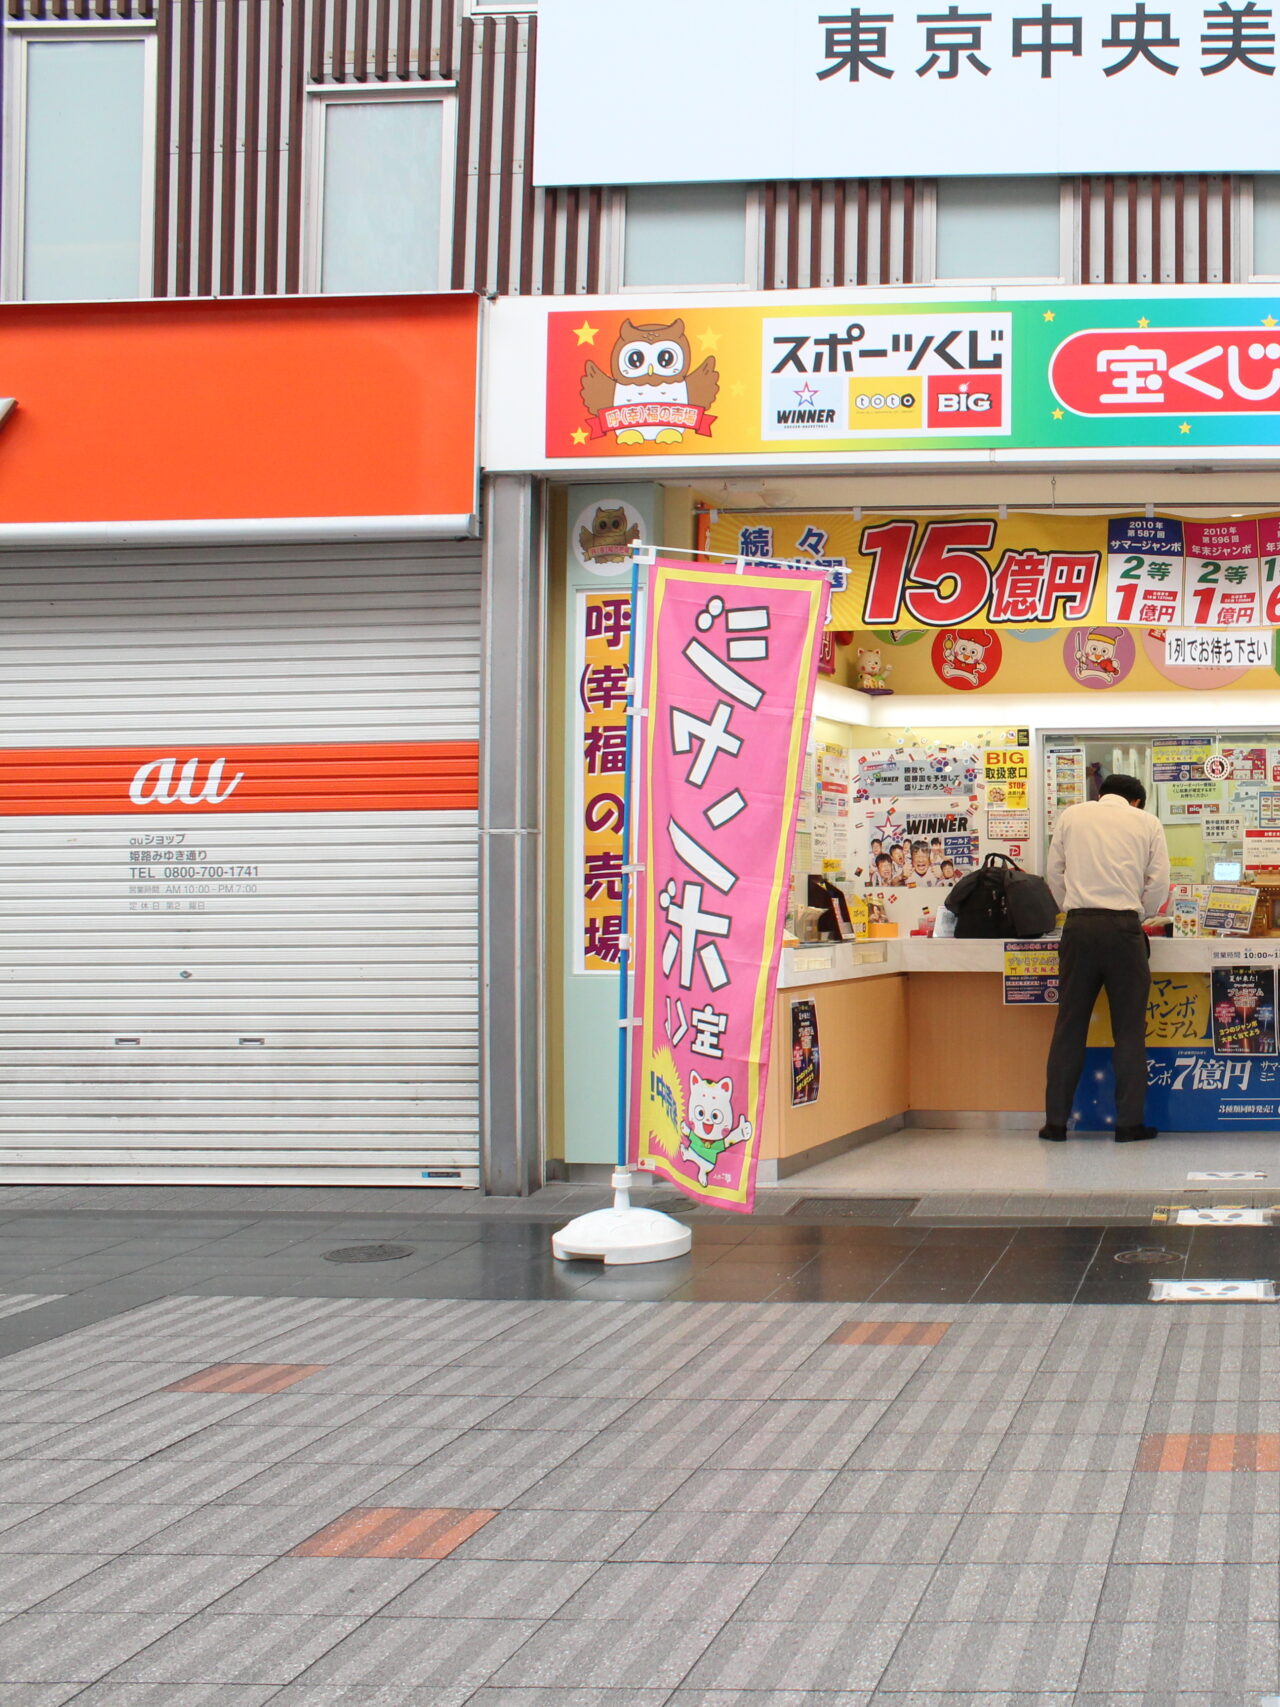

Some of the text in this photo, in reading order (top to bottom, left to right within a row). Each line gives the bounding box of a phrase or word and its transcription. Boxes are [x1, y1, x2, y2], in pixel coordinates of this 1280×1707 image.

[771, 322, 1003, 374] スポーツくじ
[777, 409, 836, 424] WINNER
[1110, 540, 1182, 552] サマージャンボ
[1191, 544, 1253, 556] 年末ジャンボ
[860, 520, 1101, 625] 15億円
[1120, 556, 1173, 581] 2等
[1197, 561, 1249, 585] 2等
[1168, 636, 1268, 664] 1列でお待ち下さい
[986, 752, 1024, 765] BIG
[985, 767, 1028, 779] 取扱窓口
[129, 757, 245, 805] au
[906, 817, 968, 835] WINNER
[129, 833, 186, 845] auショップ
[129, 850, 208, 862] 姫路みゆき通り
[129, 865, 259, 878] TEL 0800-700-1741
[1227, 988, 1265, 997] プレミアム
[1171, 1056, 1253, 1091] 7億円
[1259, 1072, 1275, 1081] ミニ
